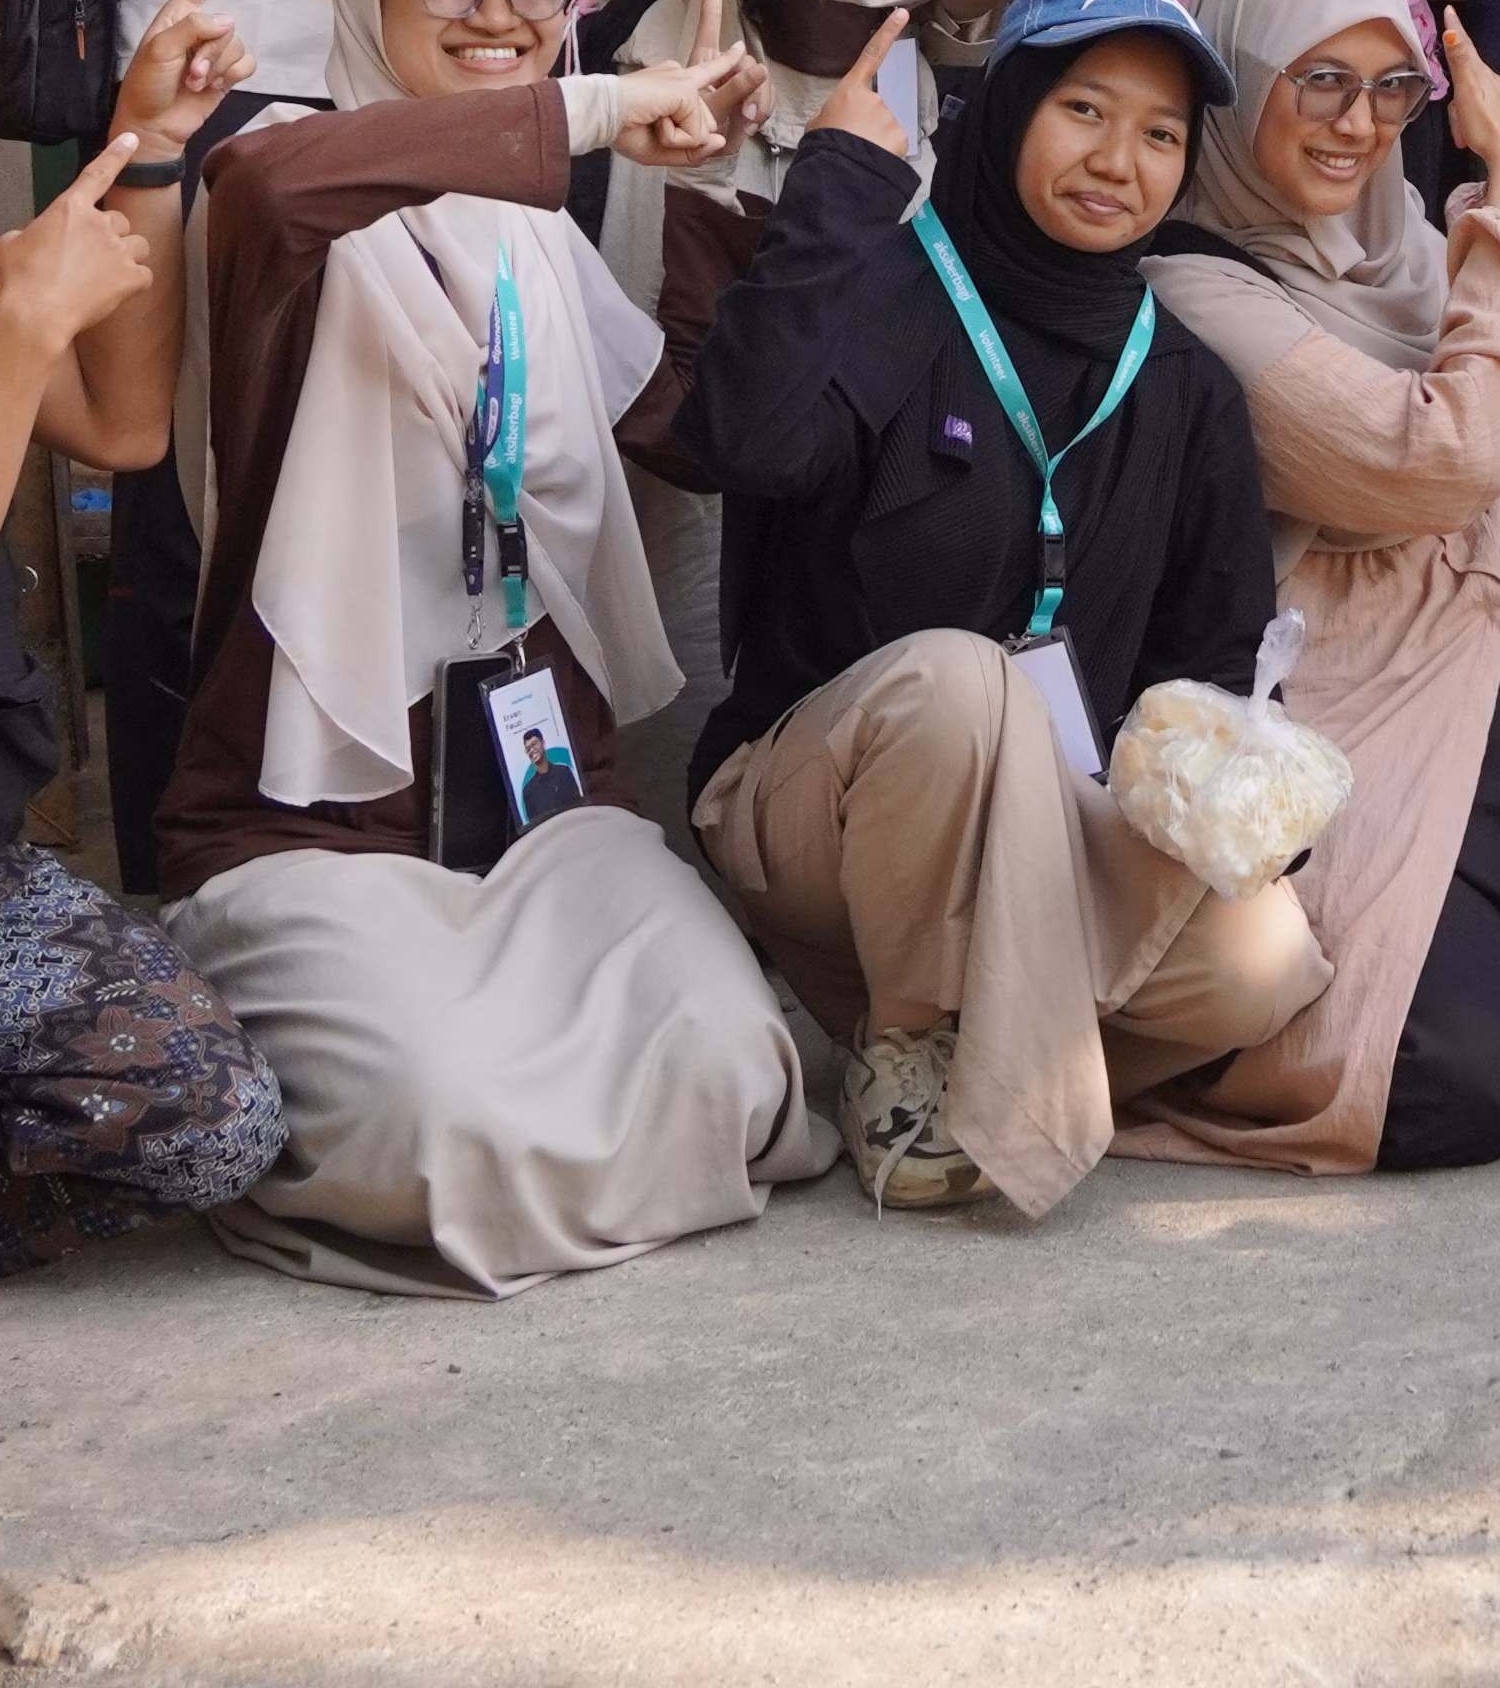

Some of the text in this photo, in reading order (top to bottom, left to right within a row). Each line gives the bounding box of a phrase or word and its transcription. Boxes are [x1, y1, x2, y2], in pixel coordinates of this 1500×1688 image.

[933, 240, 975, 302] aksiberbagi
[510, 311, 520, 361] Volunteer
[979, 329, 1007, 381] Volunteer
[505, 392, 523, 465] aksiberbagi
